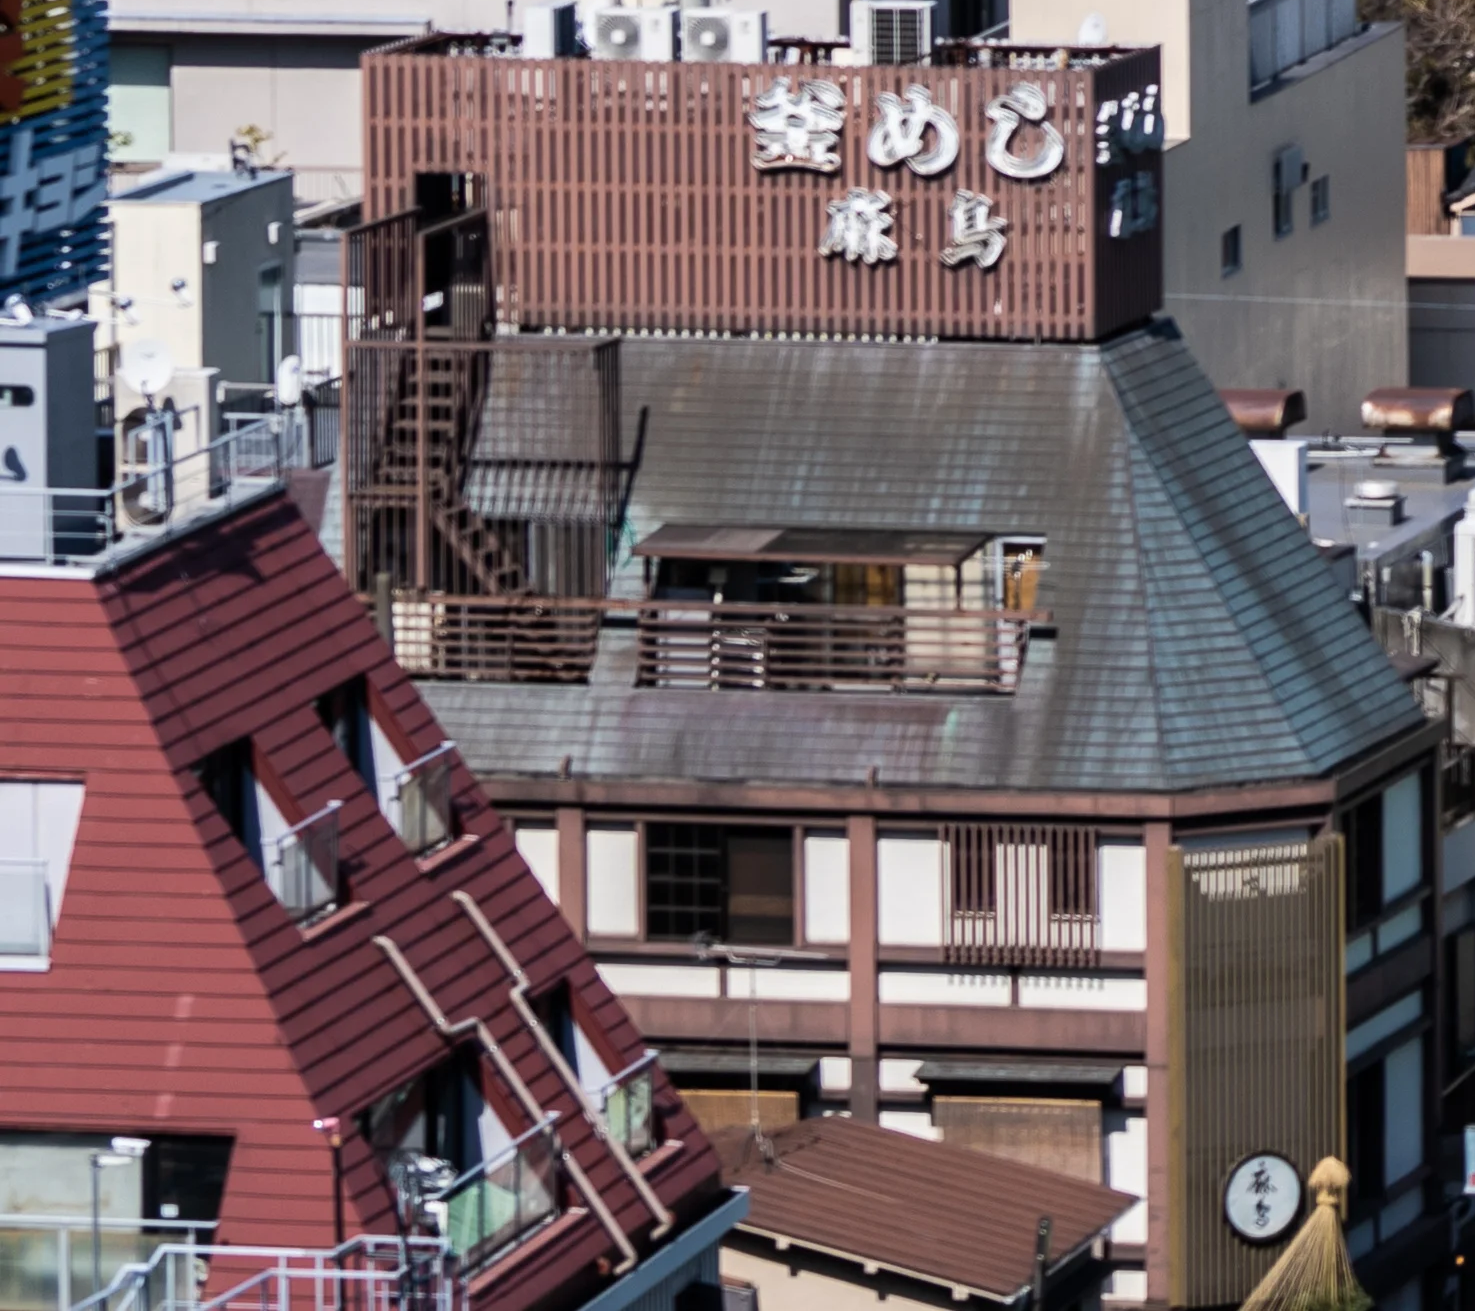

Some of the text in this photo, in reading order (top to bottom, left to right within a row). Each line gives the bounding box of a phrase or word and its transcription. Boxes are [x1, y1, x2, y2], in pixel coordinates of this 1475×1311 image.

[750, 76, 1064, 179] 釜めし
[817, 186, 1007, 270] 麻鳥
